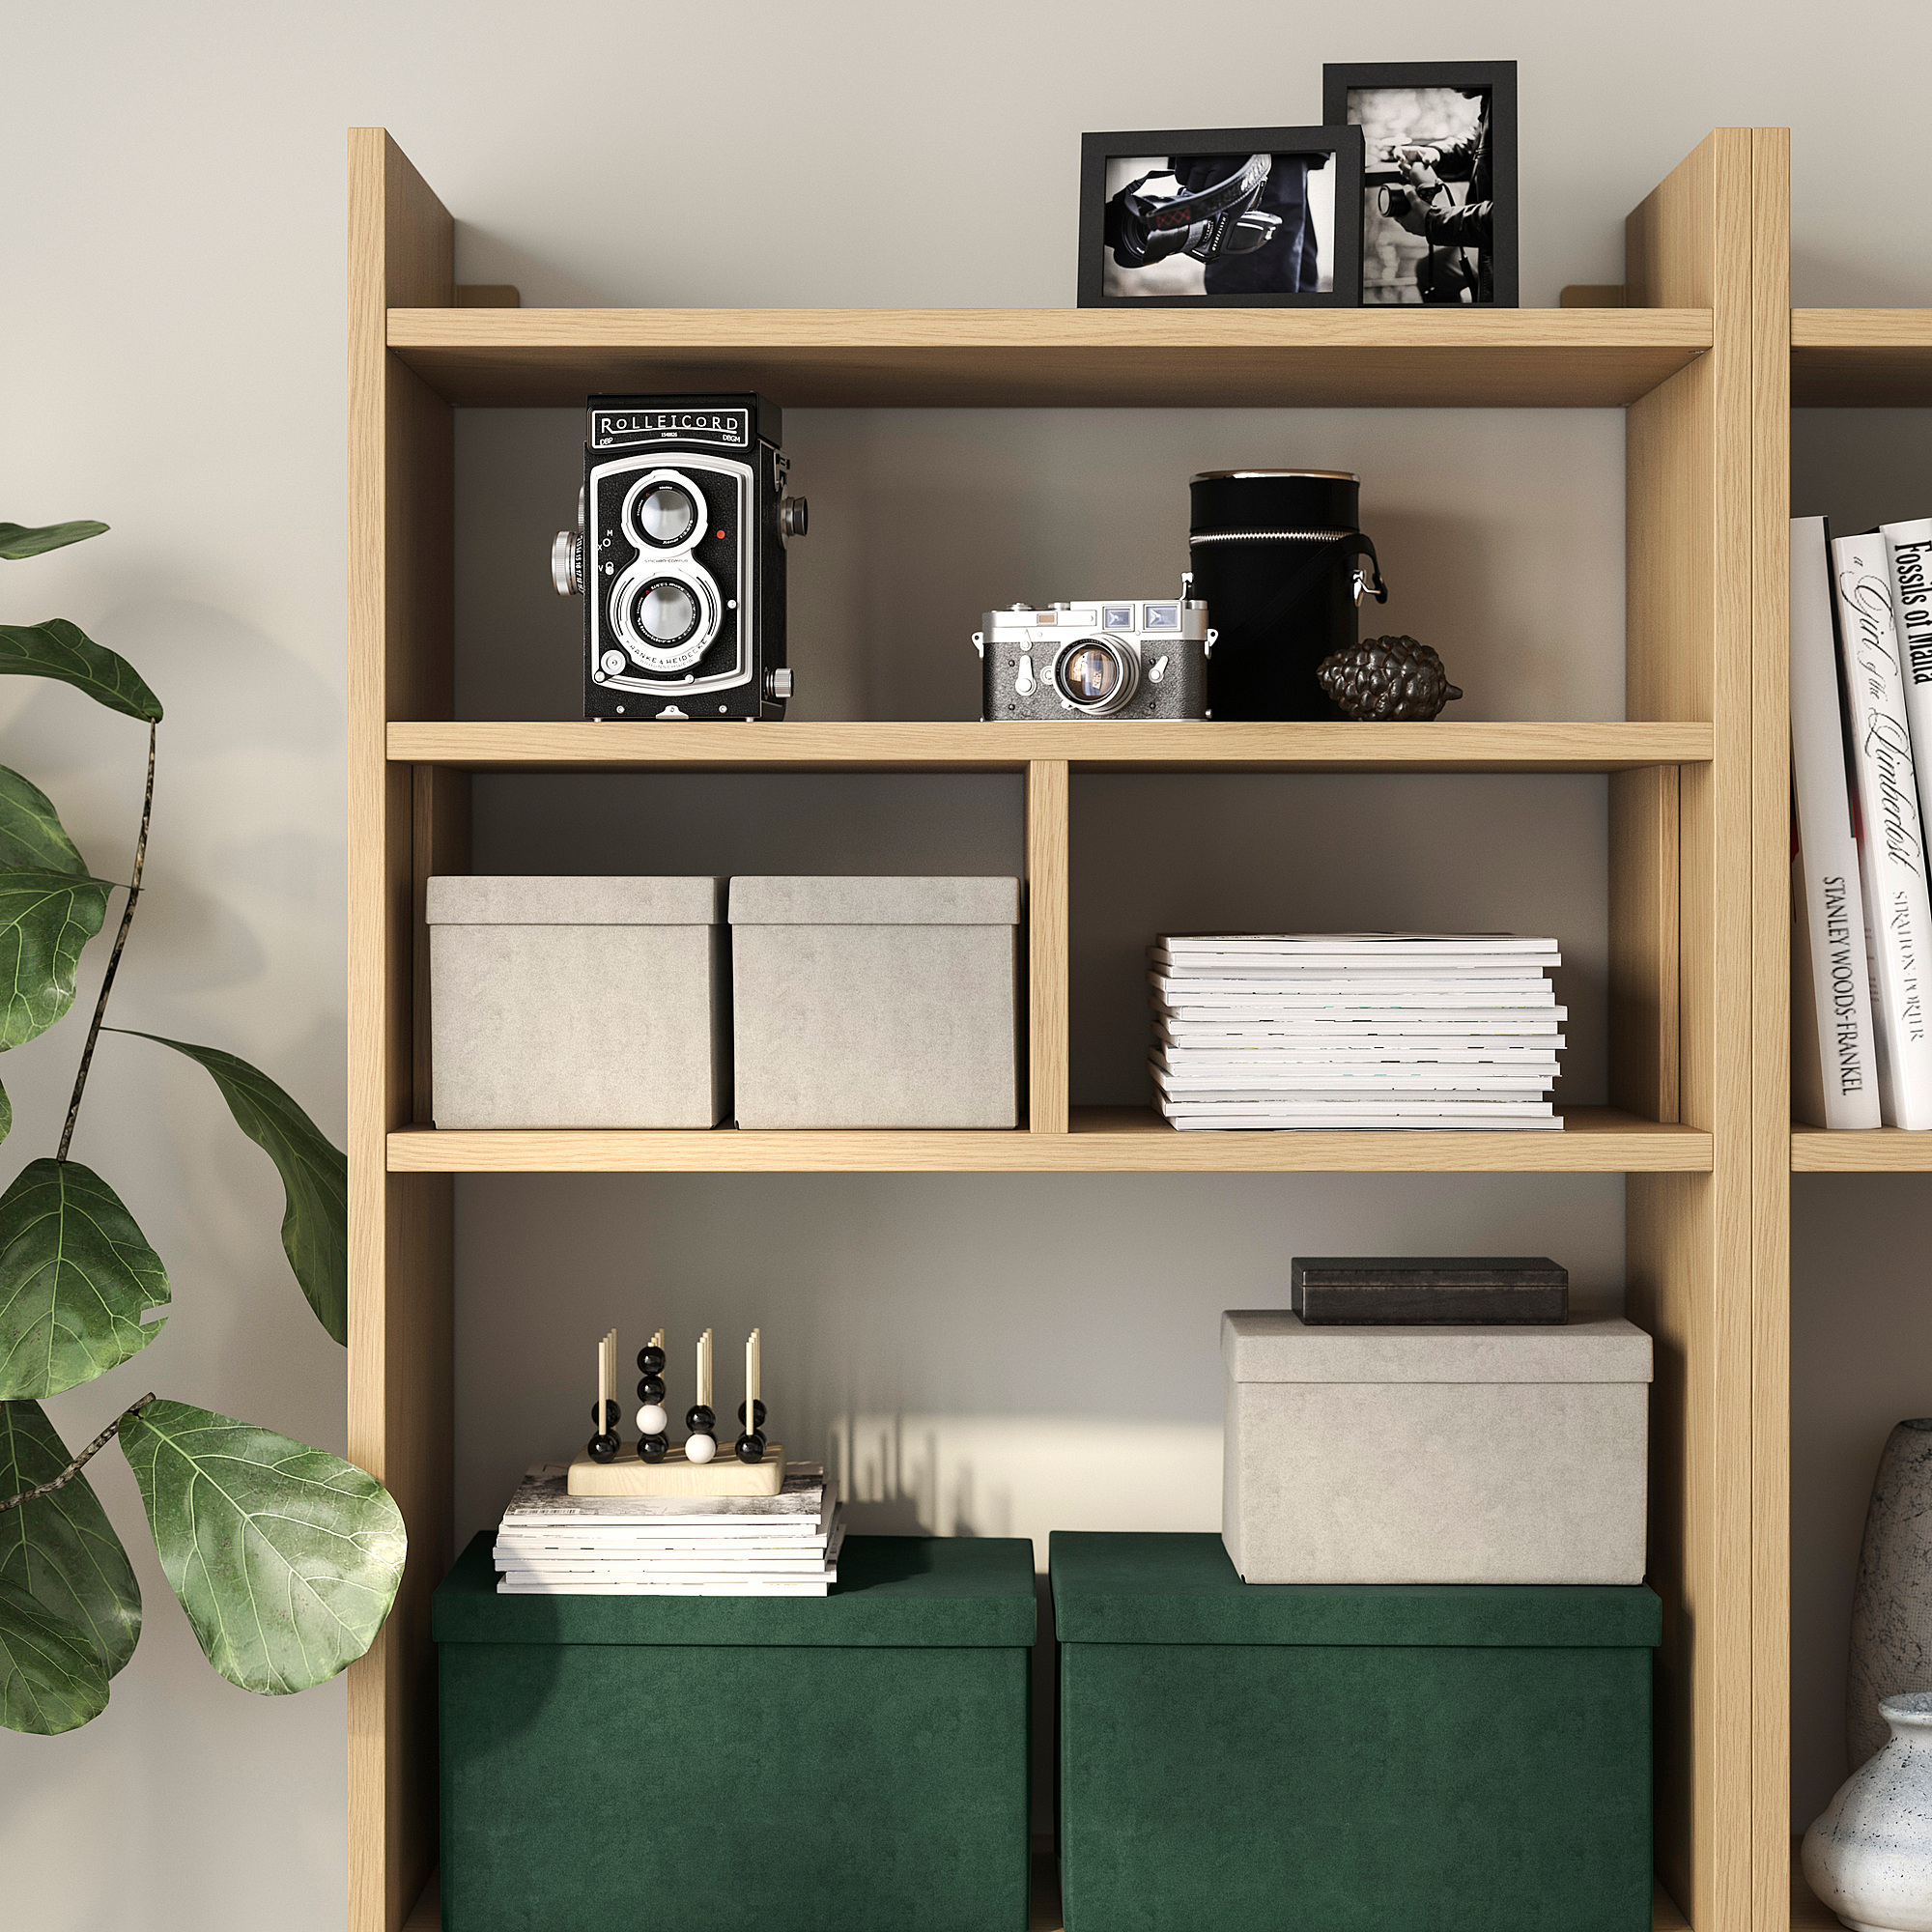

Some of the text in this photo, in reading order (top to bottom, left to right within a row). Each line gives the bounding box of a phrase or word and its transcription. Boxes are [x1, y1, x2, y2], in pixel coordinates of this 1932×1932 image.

[601, 414, 738, 435] ROLLEICORD
[1894, 540, 1932, 606] Fossils
[1823, 876, 1863, 1096] STANLEY WOODS-FRANKEL
